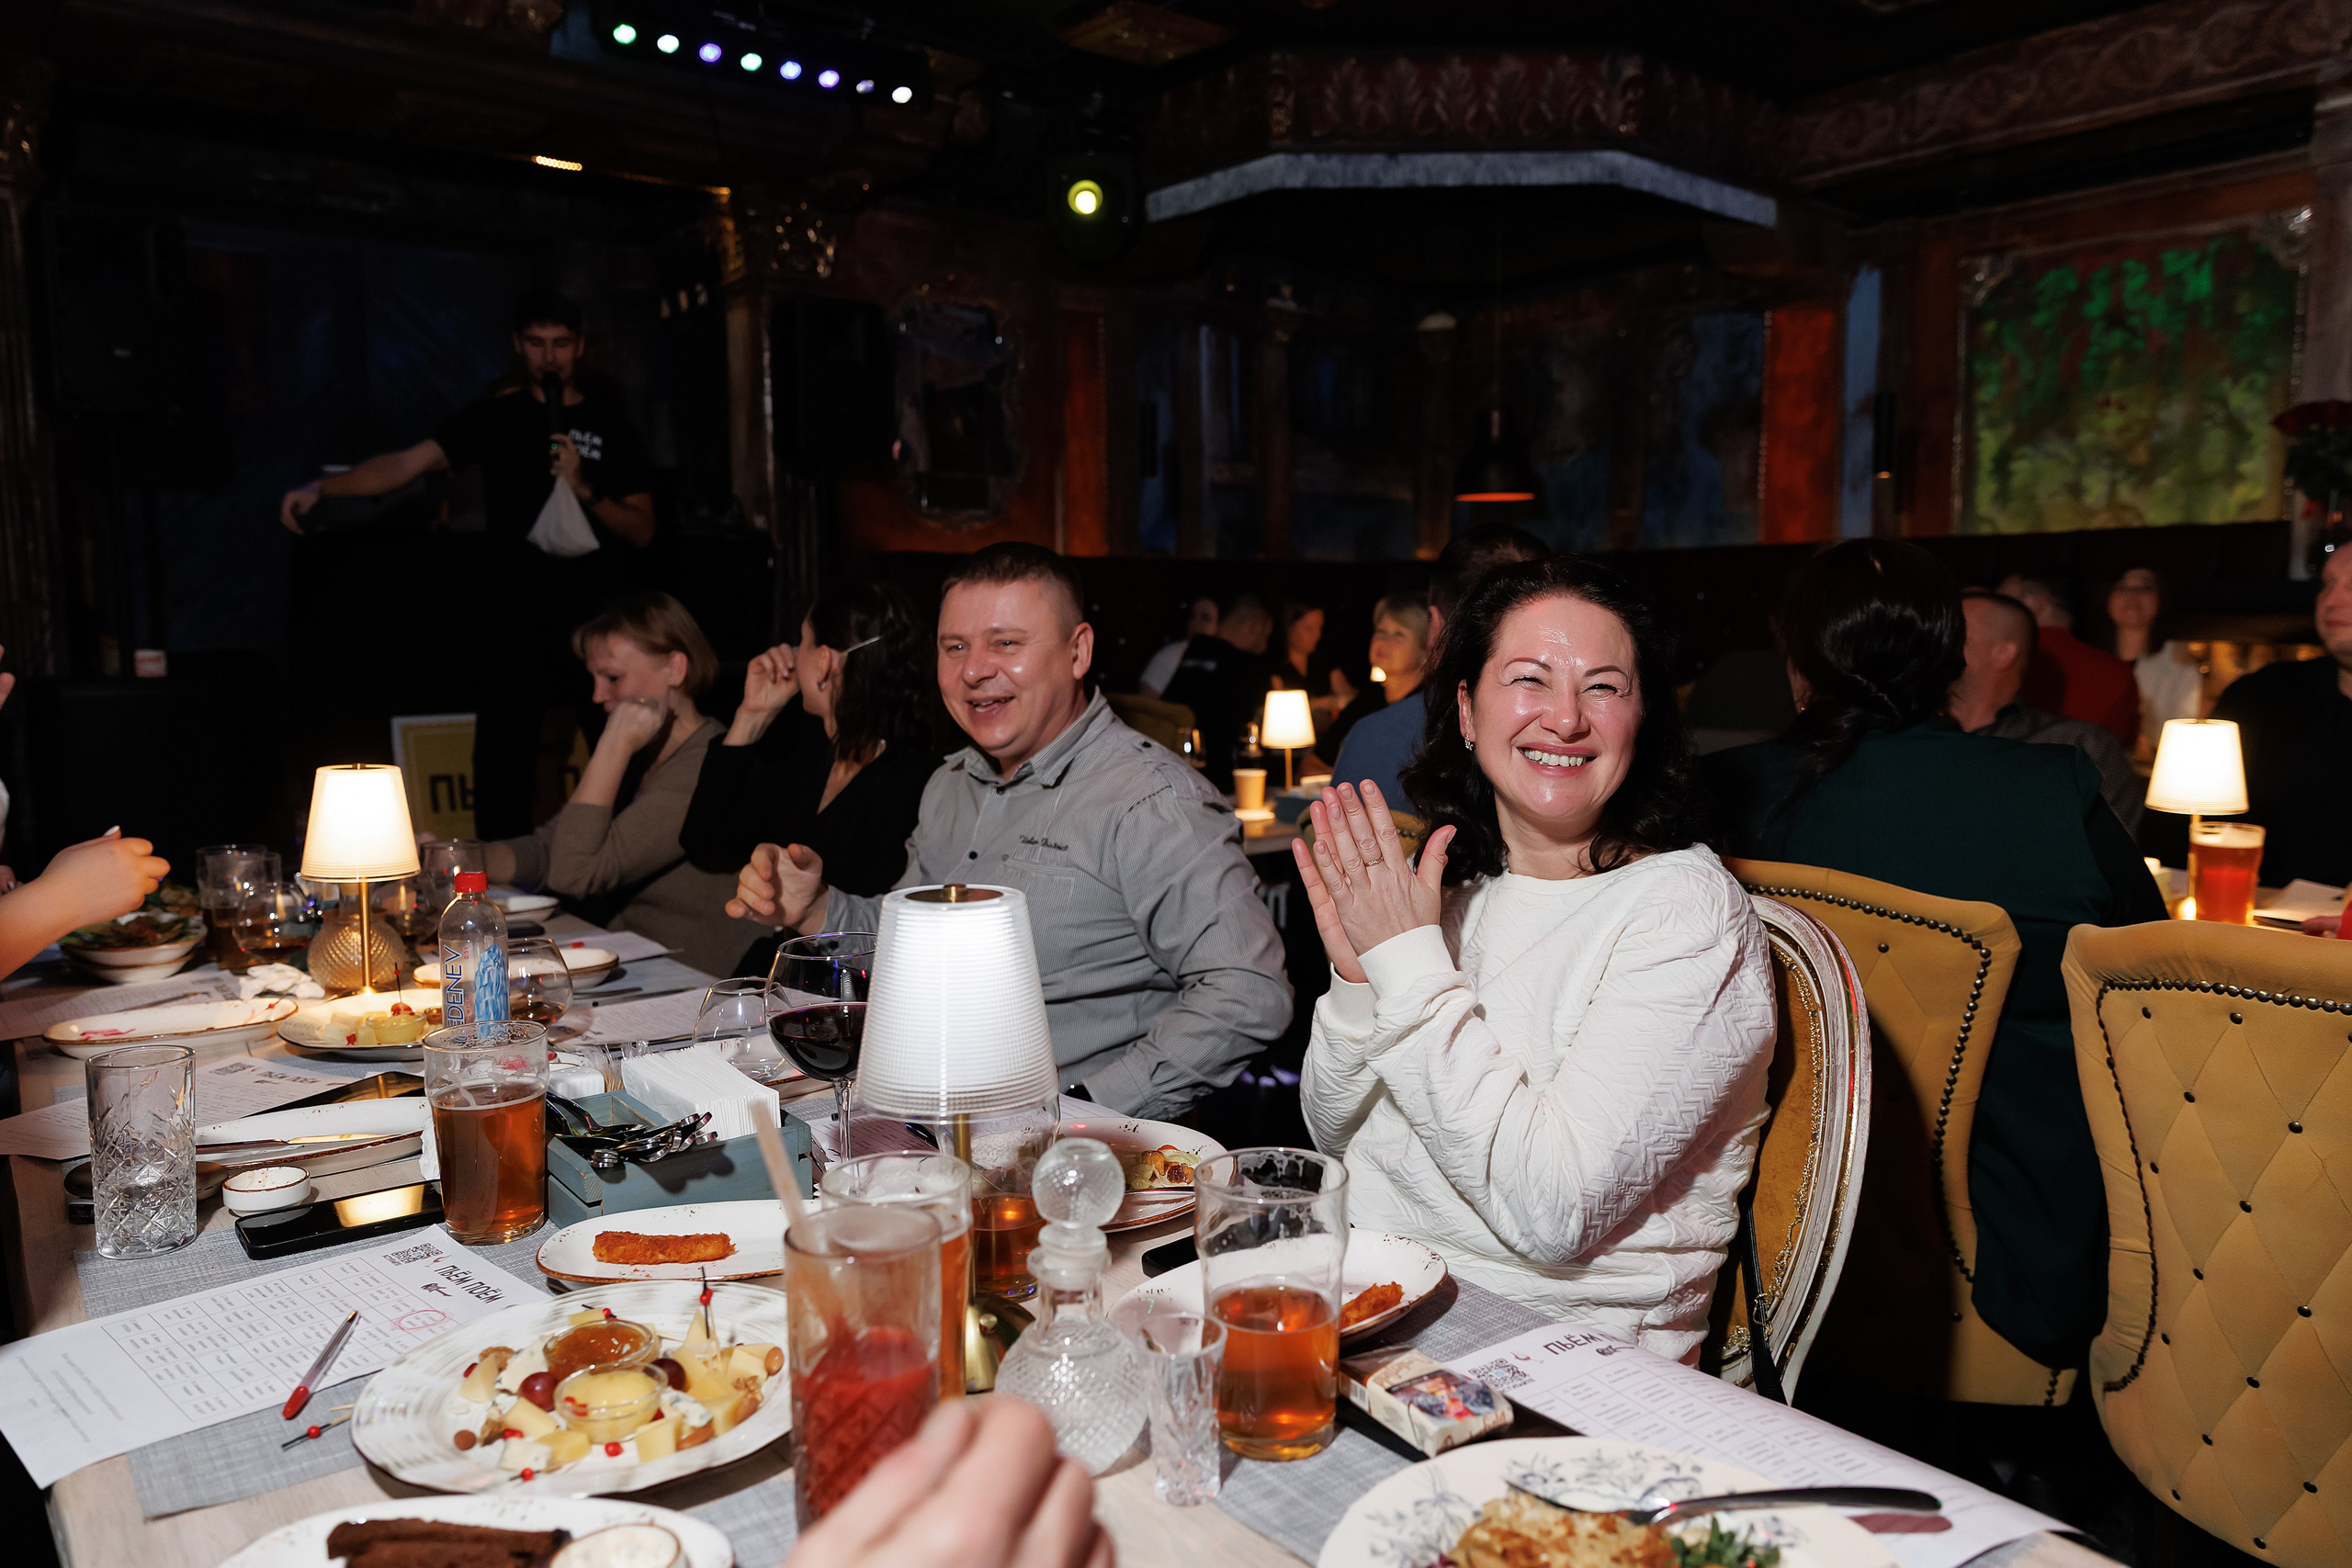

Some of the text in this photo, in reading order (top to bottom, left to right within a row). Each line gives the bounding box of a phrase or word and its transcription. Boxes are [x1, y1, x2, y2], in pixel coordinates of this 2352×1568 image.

[429, 773, 476, 814] ПЬ
[444, 944, 465, 1028] EDENEV
[434, 1264, 505, 1304] ПЬЁМ ПОЁМ
[1543, 1333, 1604, 1356] ПЬЁМ
